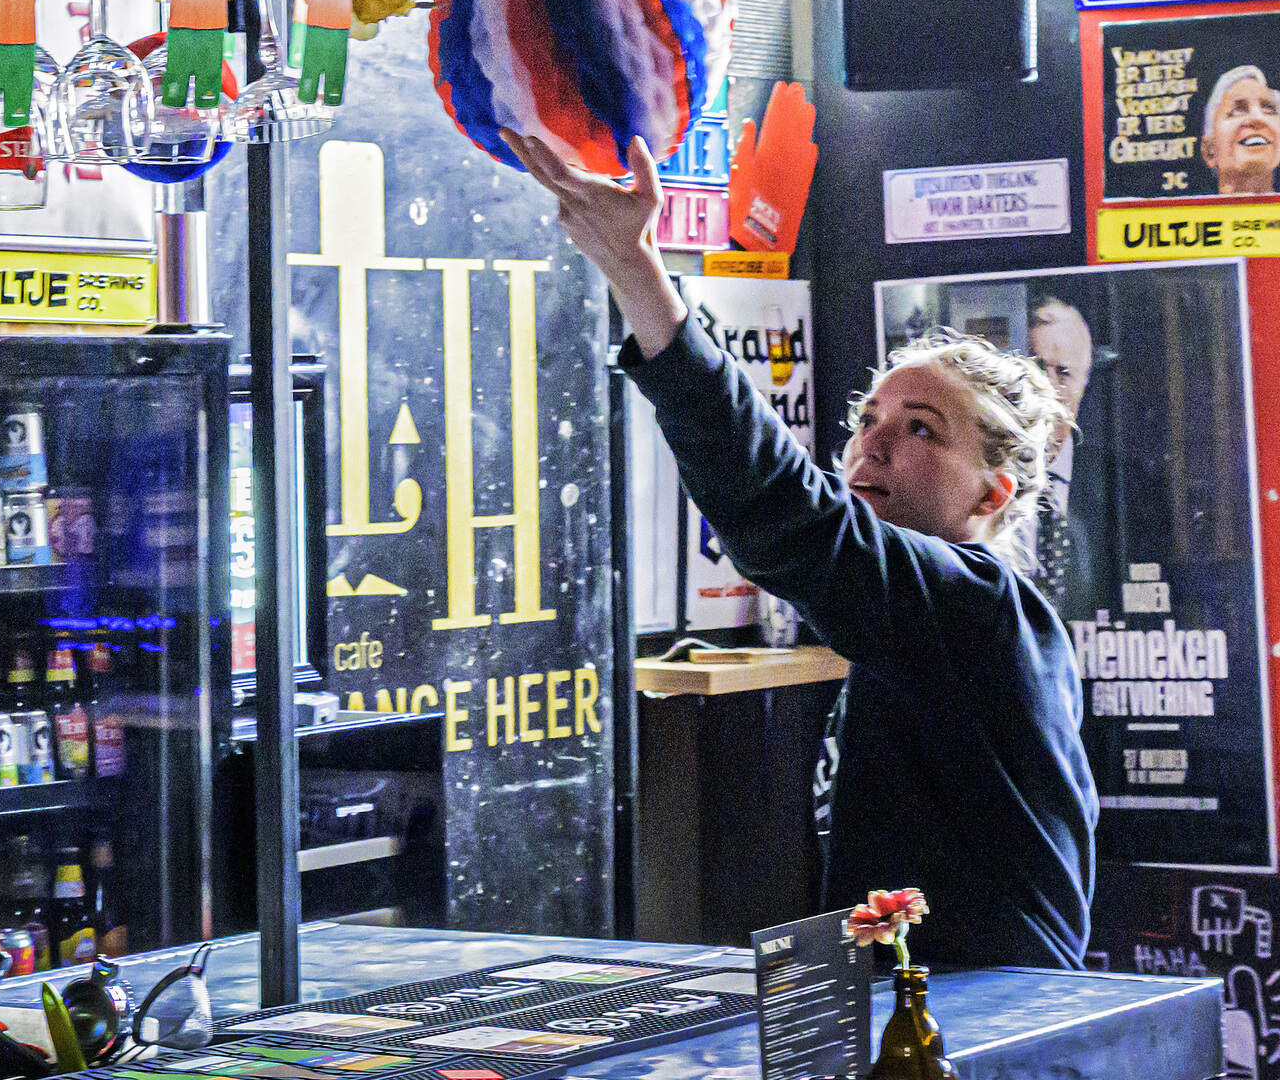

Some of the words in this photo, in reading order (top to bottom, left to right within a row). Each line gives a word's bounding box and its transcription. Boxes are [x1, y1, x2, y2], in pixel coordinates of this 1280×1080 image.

[1123, 221, 1223, 249] UILTJE
[334, 631, 384, 672] cafe
[1070, 620, 1229, 680] Heineken
[487, 668, 602, 748] HEER
[1134, 944, 1207, 976] HAHA
